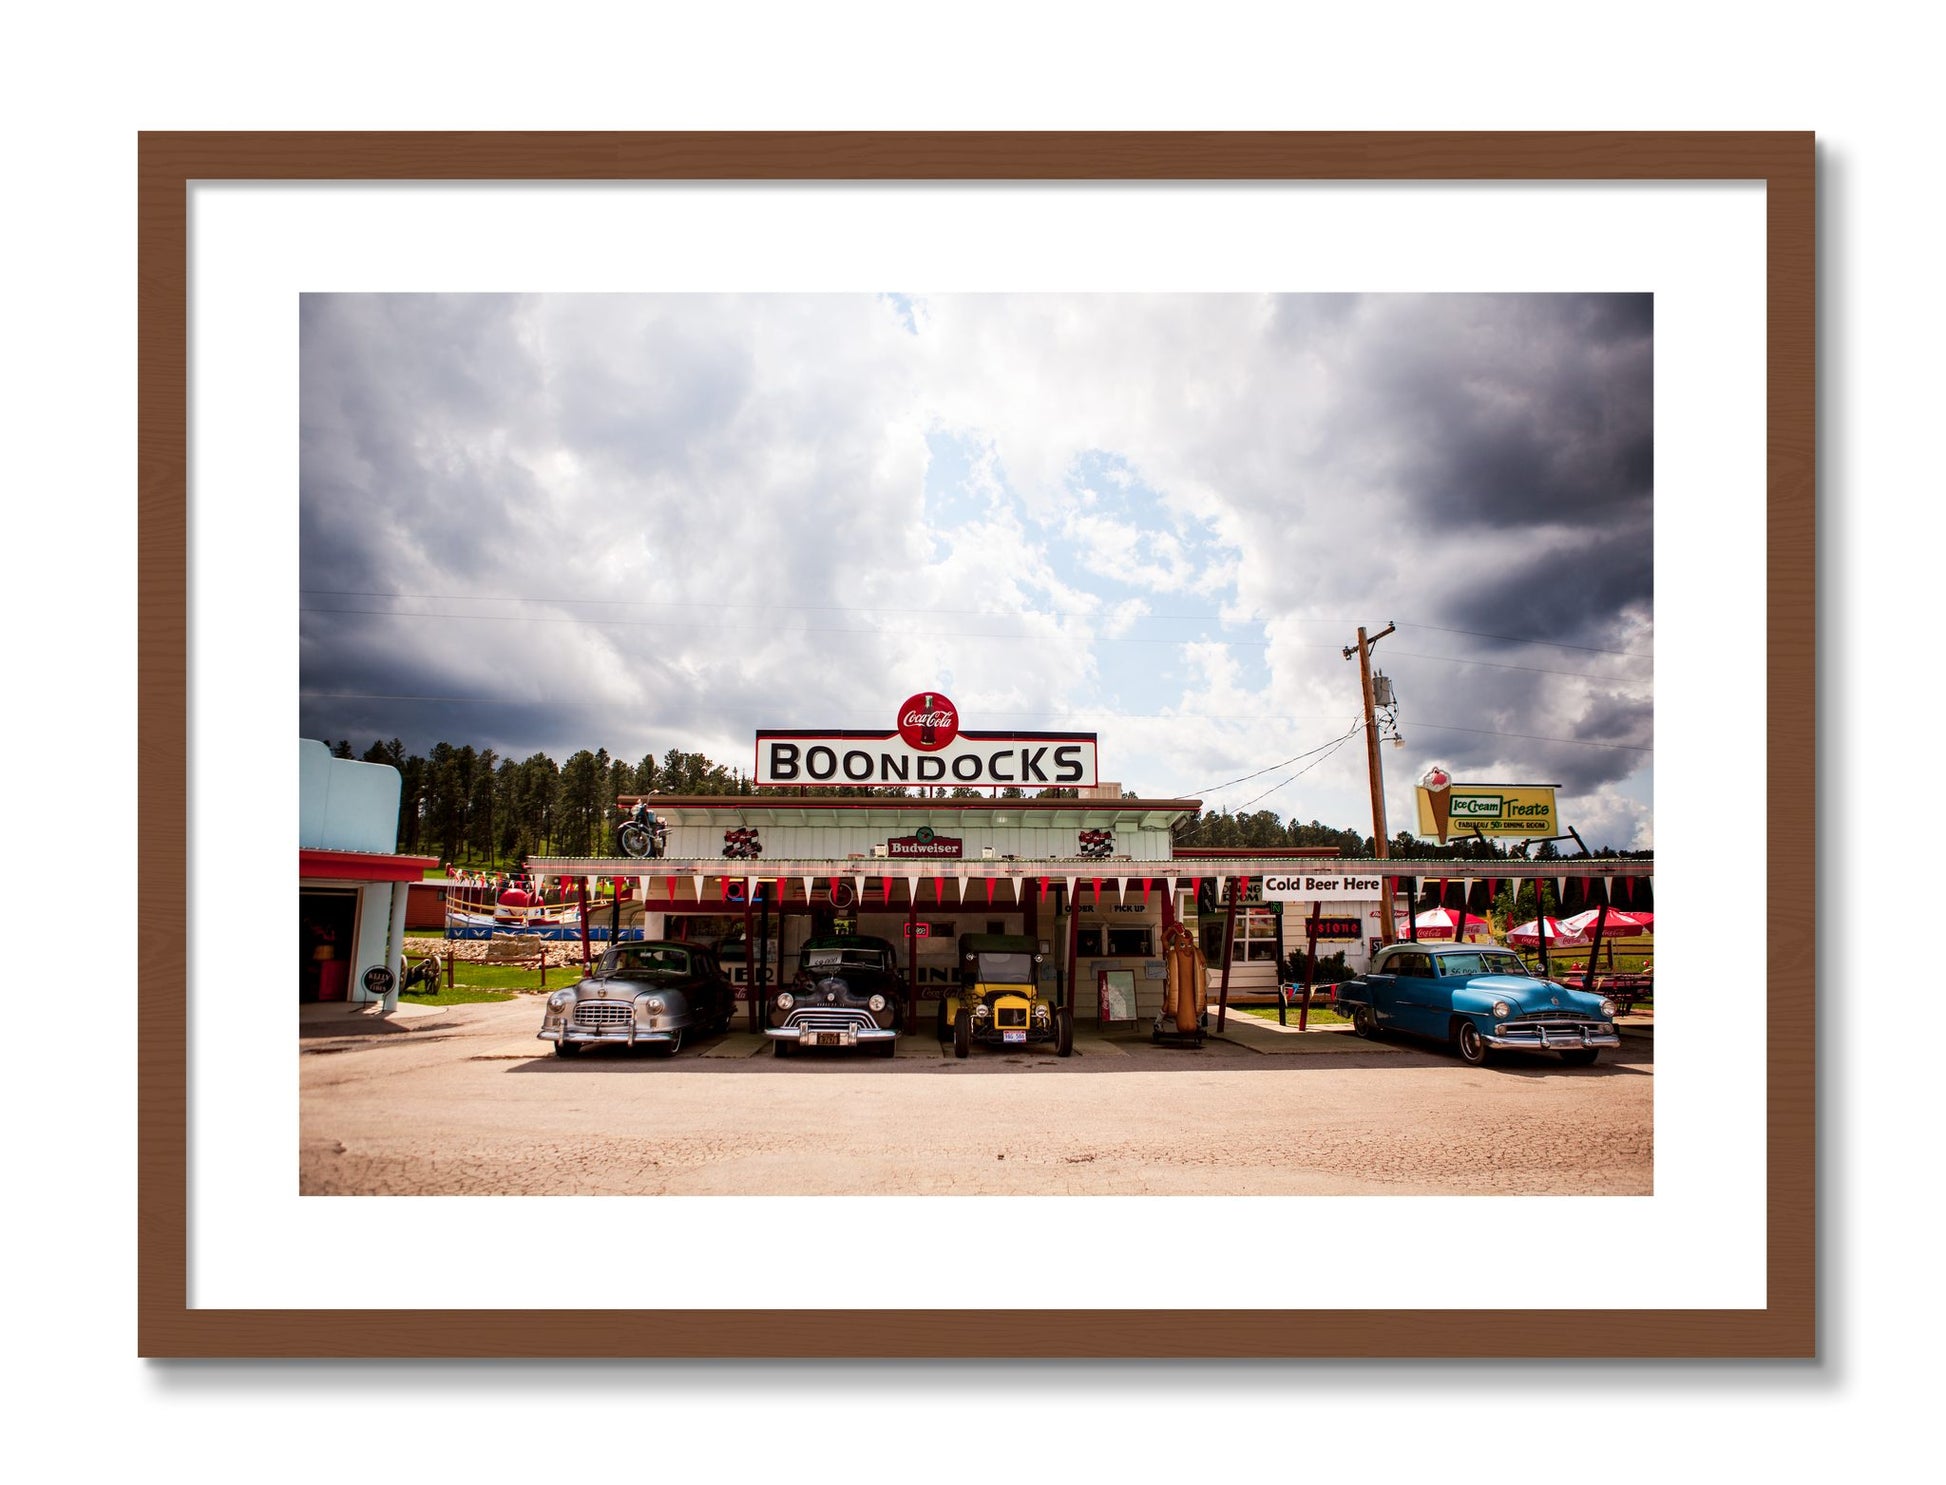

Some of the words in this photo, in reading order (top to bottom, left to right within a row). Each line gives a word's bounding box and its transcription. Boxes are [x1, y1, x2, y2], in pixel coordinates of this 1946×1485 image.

[903, 710, 953, 728] Coca-Cola
[770, 743, 1084, 782] BOONDOCKS
[1454, 800, 1467, 811] Ice
[1467, 800, 1499, 813] Cream
[1503, 799, 1549, 817] Treats
[891, 843, 959, 853] Budweiser
[1266, 877, 1300, 891] Cold
[1305, 877, 1339, 891] Beer
[1343, 877, 1380, 891] Here
[1223, 894, 1259, 902] ROM
[1065, 905, 1094, 913] ODER
